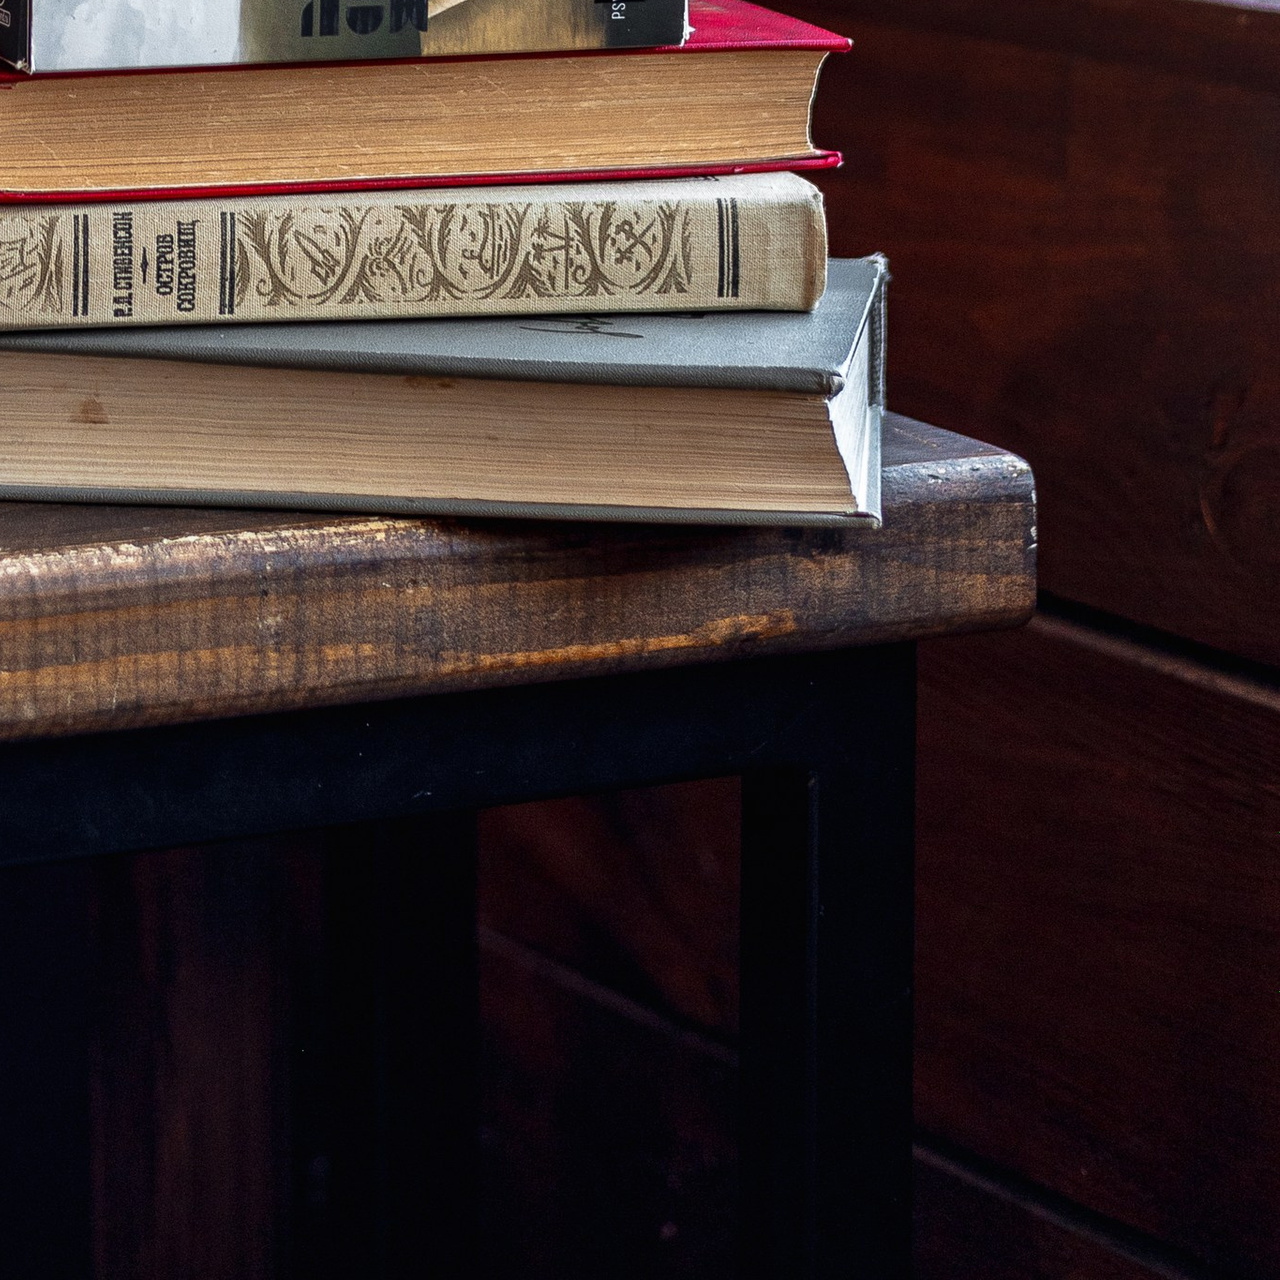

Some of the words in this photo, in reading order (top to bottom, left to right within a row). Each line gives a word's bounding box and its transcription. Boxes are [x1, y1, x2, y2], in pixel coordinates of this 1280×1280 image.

[113, 211, 133, 290] СТИВЕНСОН
[156, 233, 174, 296] ОСТРОВ
[177, 219, 200, 312] СОКРОВИЩ
